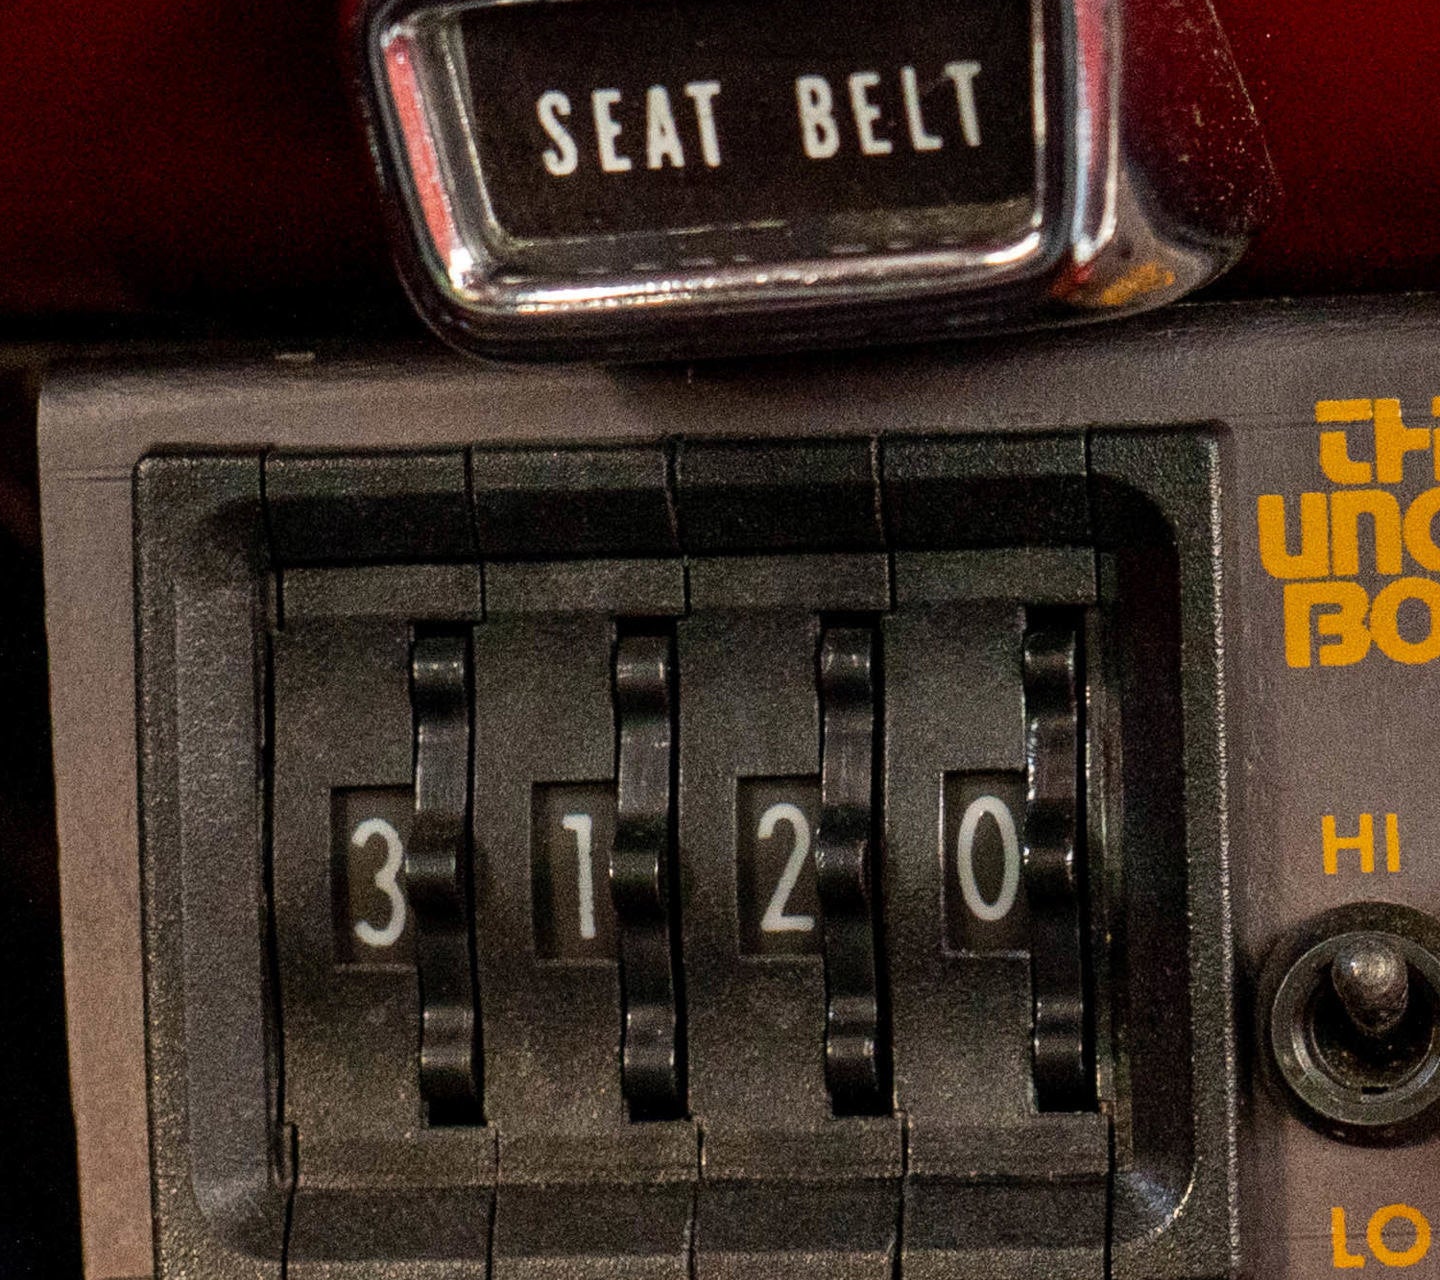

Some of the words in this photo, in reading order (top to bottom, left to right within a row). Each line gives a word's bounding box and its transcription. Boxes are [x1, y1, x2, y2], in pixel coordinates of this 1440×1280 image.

[536, 80, 722, 176] SEAT
[795, 61, 982, 160] BELT
[1320, 812, 1401, 876] HI
[1330, 1202, 1433, 1270] LO
